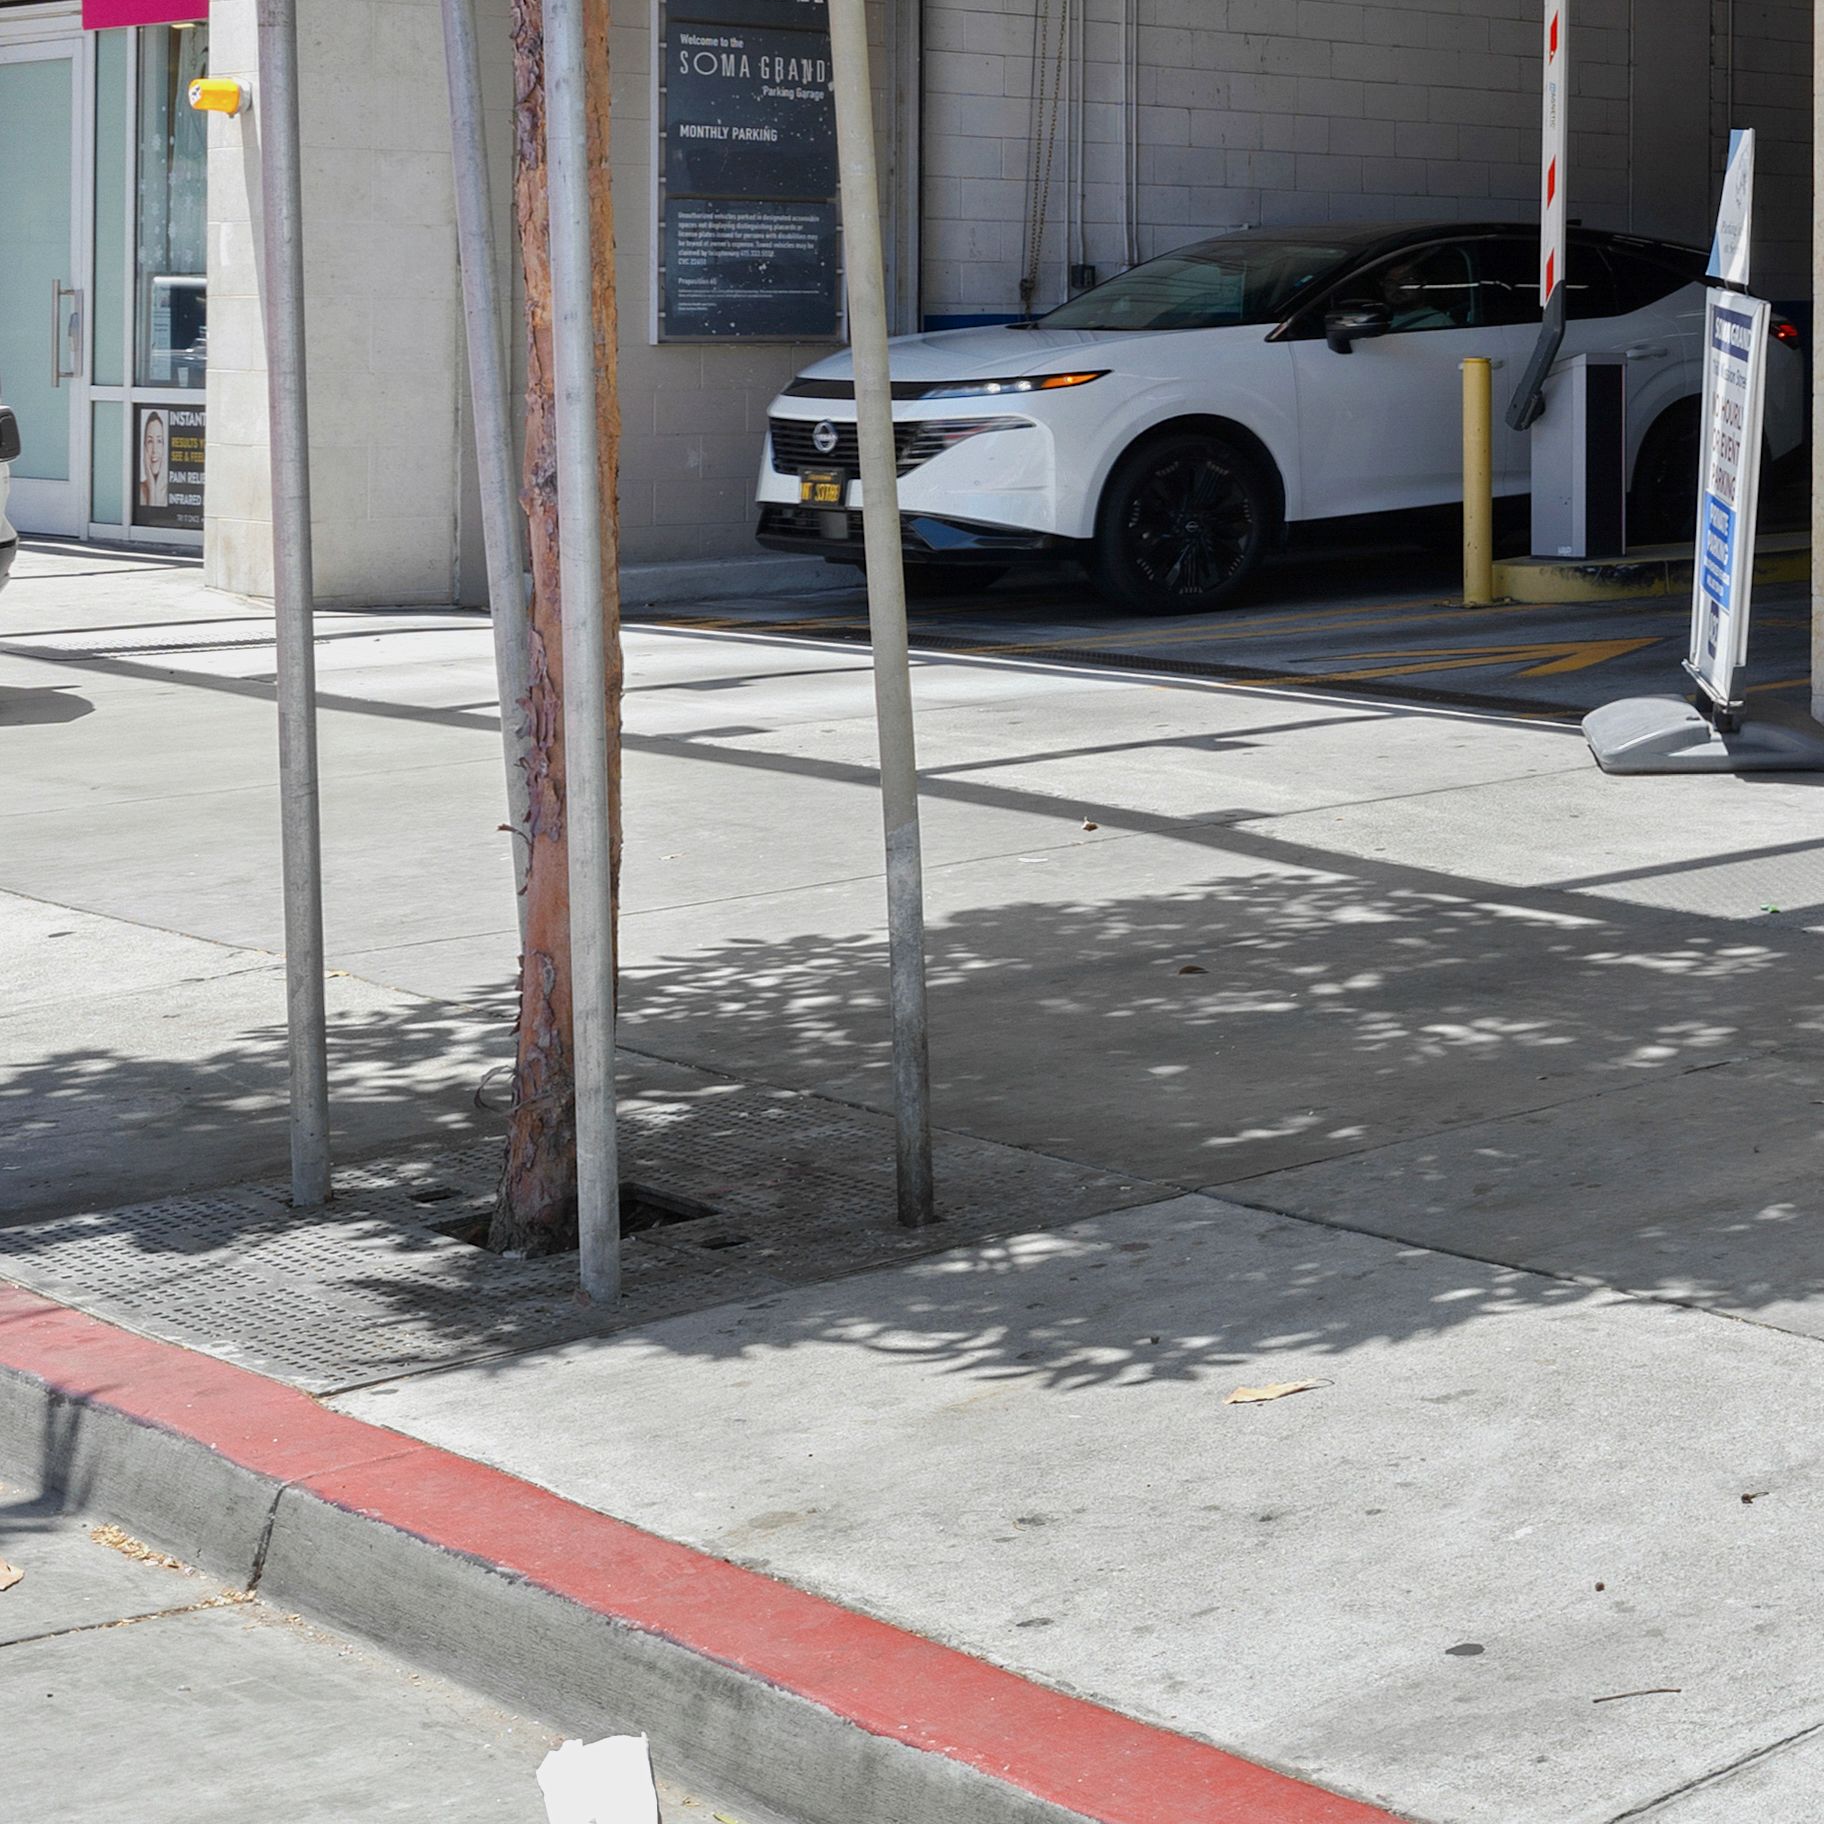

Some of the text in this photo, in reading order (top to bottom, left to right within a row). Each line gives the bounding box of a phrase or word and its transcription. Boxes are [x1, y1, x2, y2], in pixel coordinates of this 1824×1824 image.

[680, 33, 744, 48] Welcome to the
[680, 50, 825, 83] SOMA GRAND
[762, 85, 825, 102] Parking Garage
[680, 125, 778, 142] MONTHLY PARKING
[169, 471, 187, 483] PAIN
[169, 493, 201, 506] INFRARED
